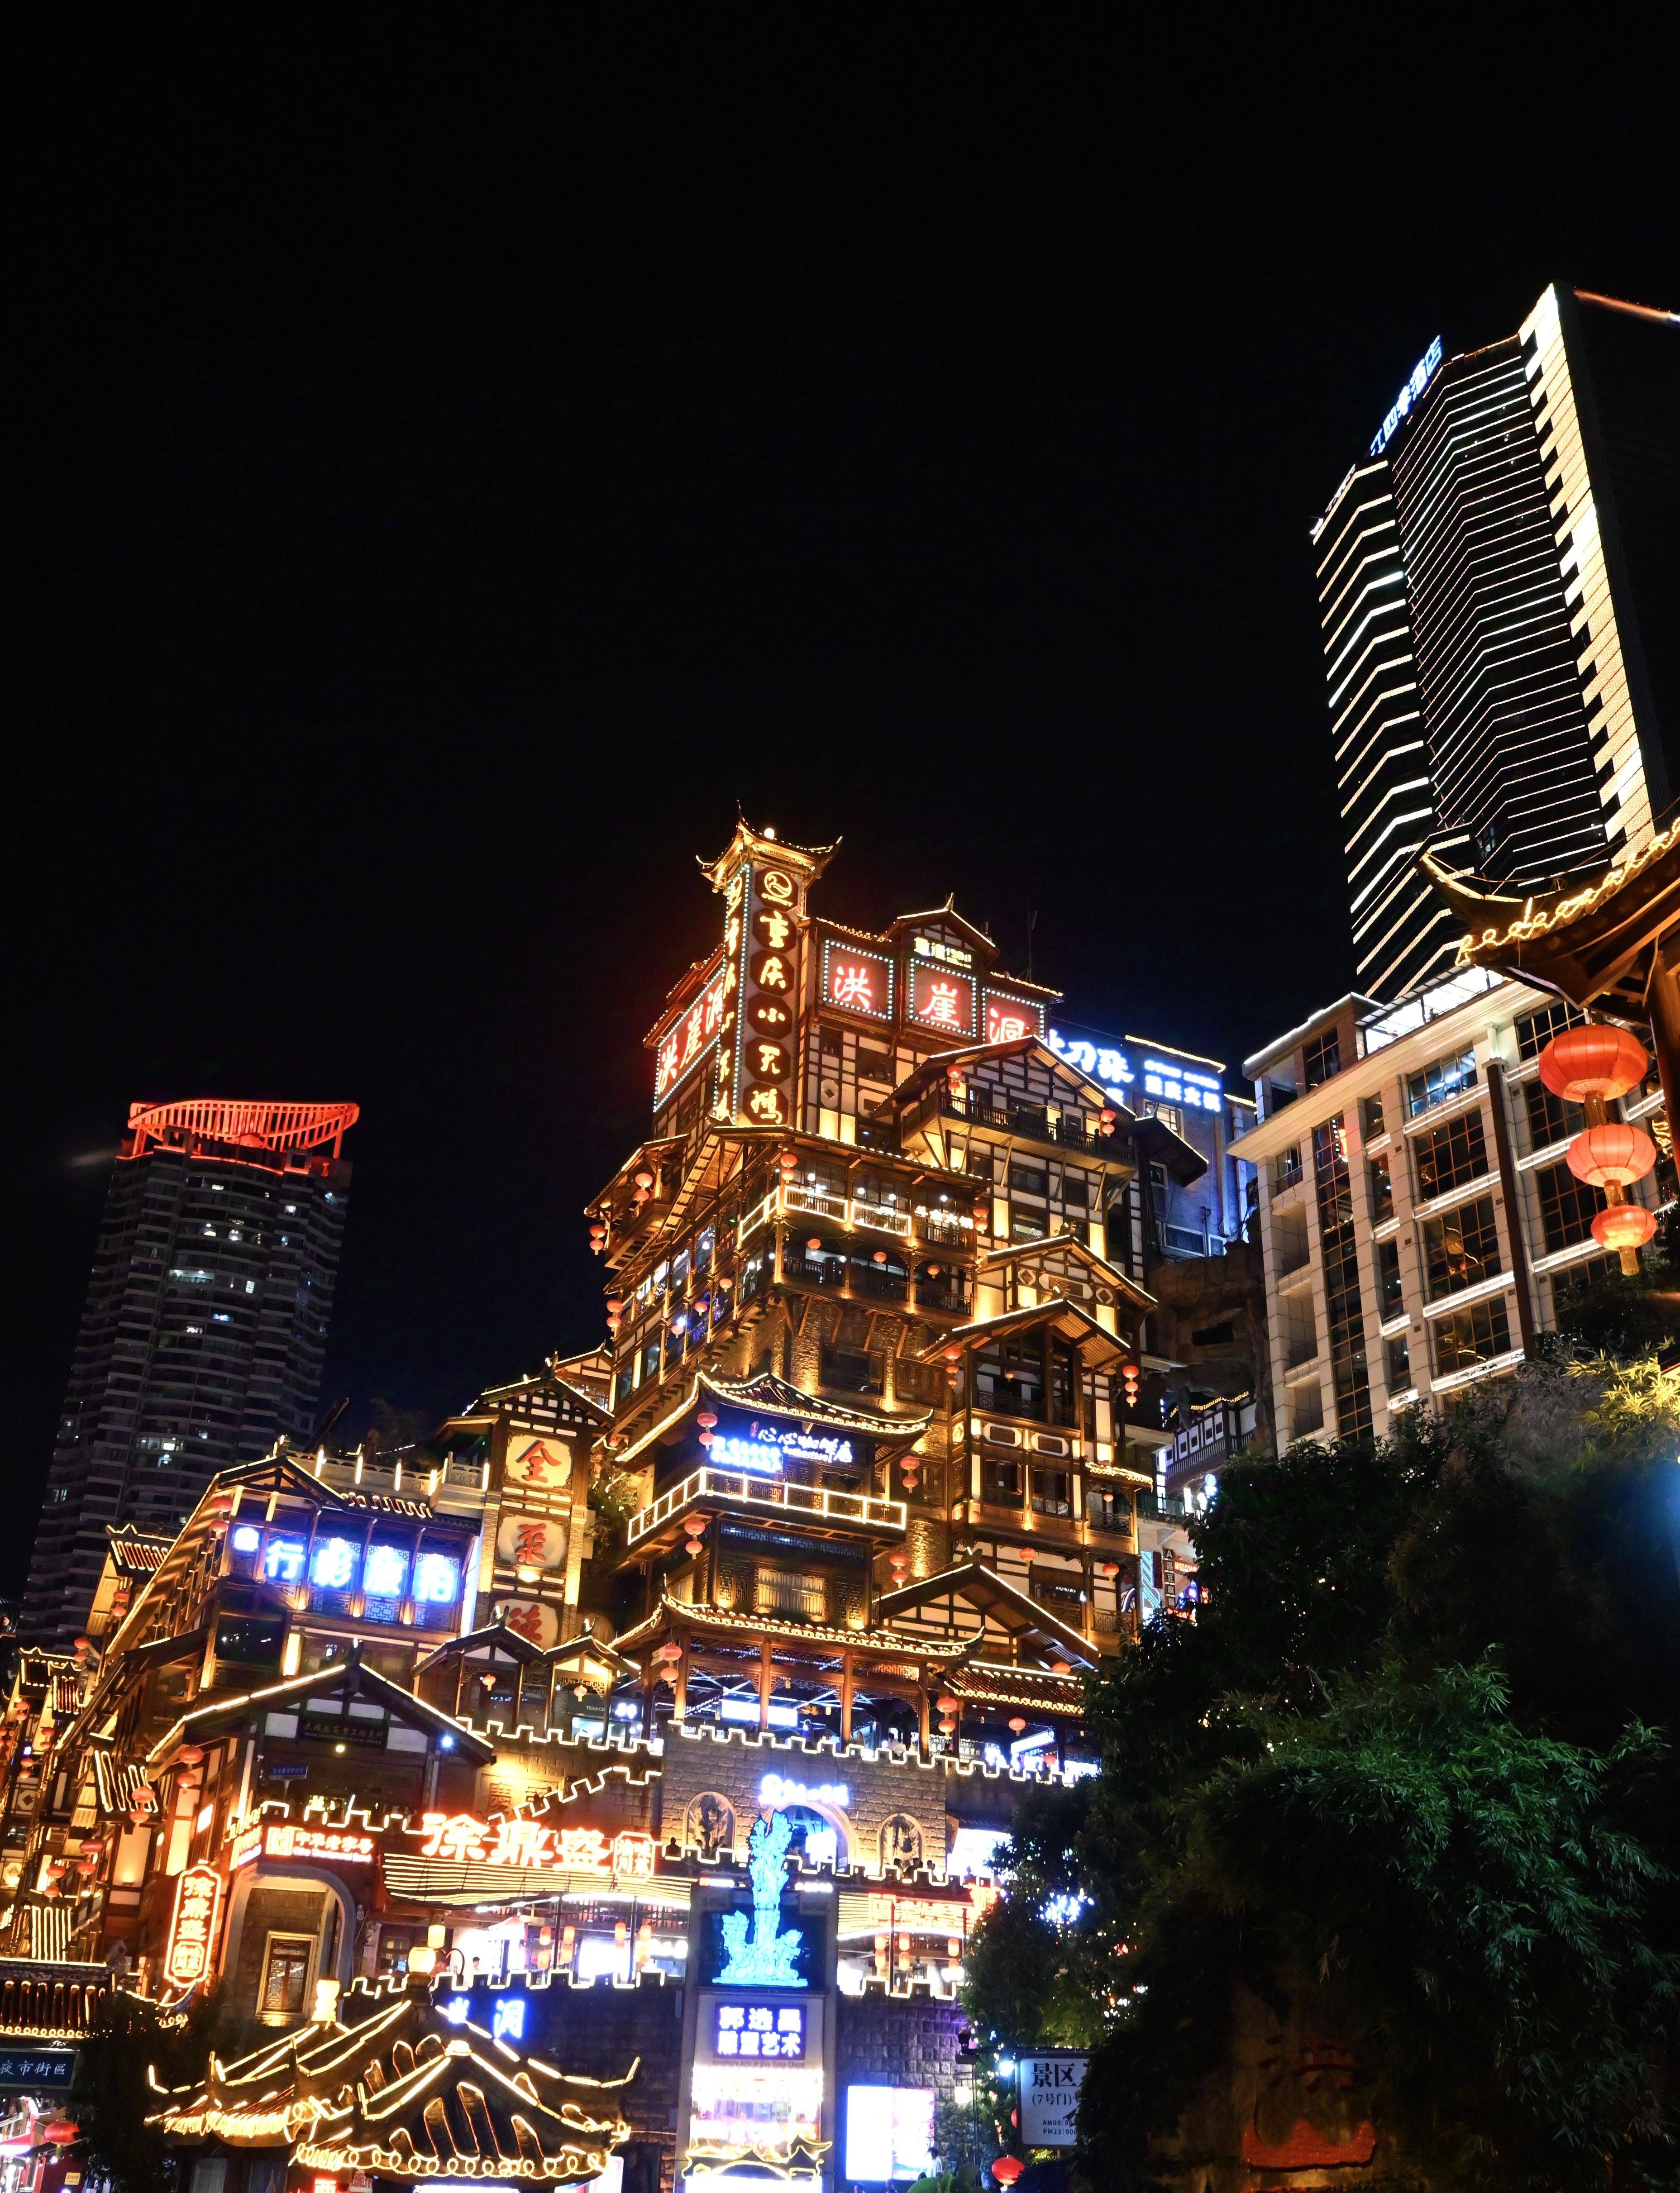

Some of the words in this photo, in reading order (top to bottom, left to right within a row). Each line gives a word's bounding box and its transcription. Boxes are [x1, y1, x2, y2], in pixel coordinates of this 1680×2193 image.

[751, 910, 789, 1125] 重庆小天鹅
[834, 965, 1026, 1043] 洪崖洞
[658, 982, 724, 1094] 洪崖洞
[296, 1831, 374, 1854] 中华老字号
[421, 1813, 611, 1877] 徐鼎盛
[176, 1876, 215, 1941] 徐鼎盛
[0, 2060, 66, 2076] 夜市街區
[717, 2030, 801, 2057] 雕塑艺术
